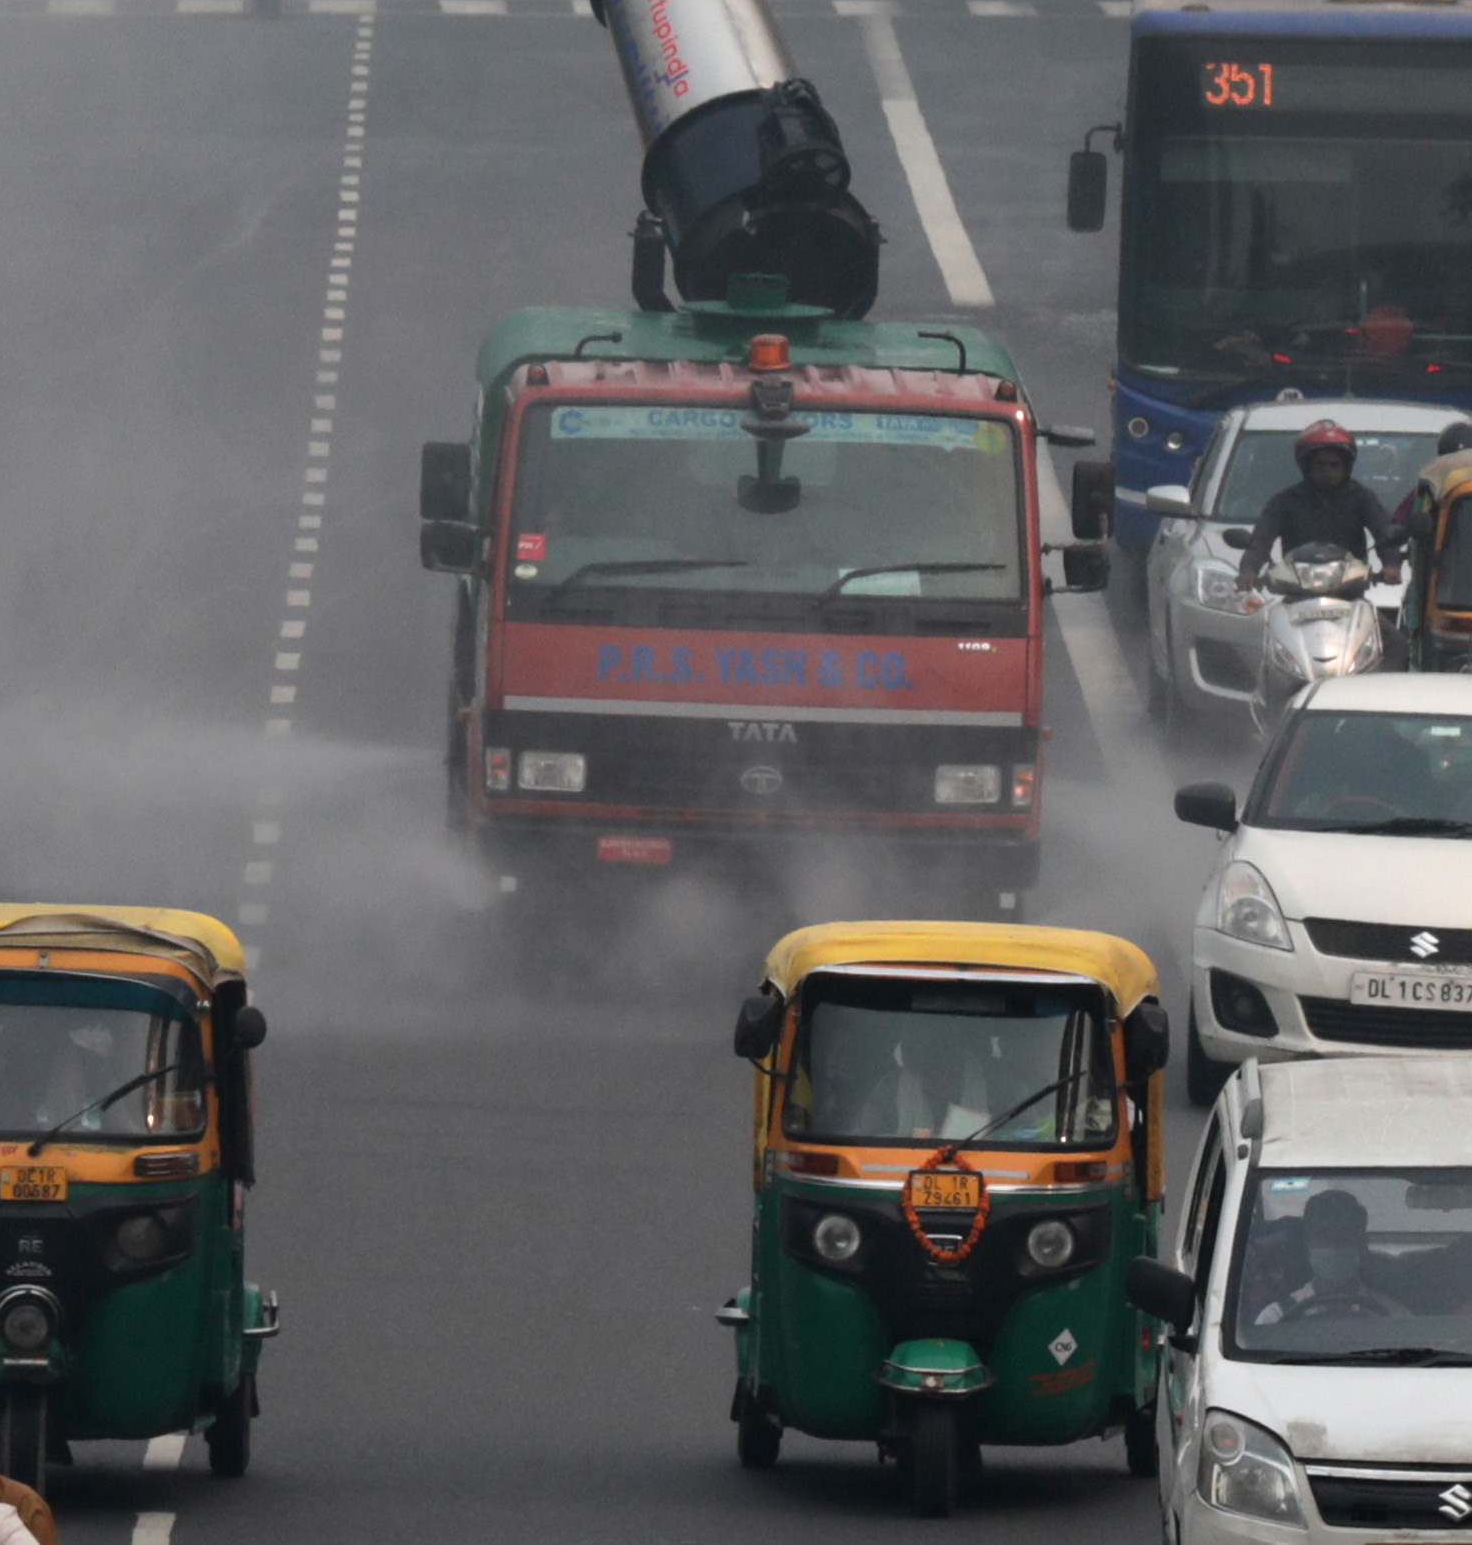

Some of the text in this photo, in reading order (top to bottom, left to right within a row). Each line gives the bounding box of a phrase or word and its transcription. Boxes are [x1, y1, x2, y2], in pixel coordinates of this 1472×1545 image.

[1205, 63, 1273, 106] 351
[647, 408, 736, 429] CARGO
[714, 646, 807, 686] YASH
[817, 650, 843, 686] &
[856, 651, 914, 689] CO.
[729, 721, 798, 743] TATA
[18, 1239, 44, 1254] RE
